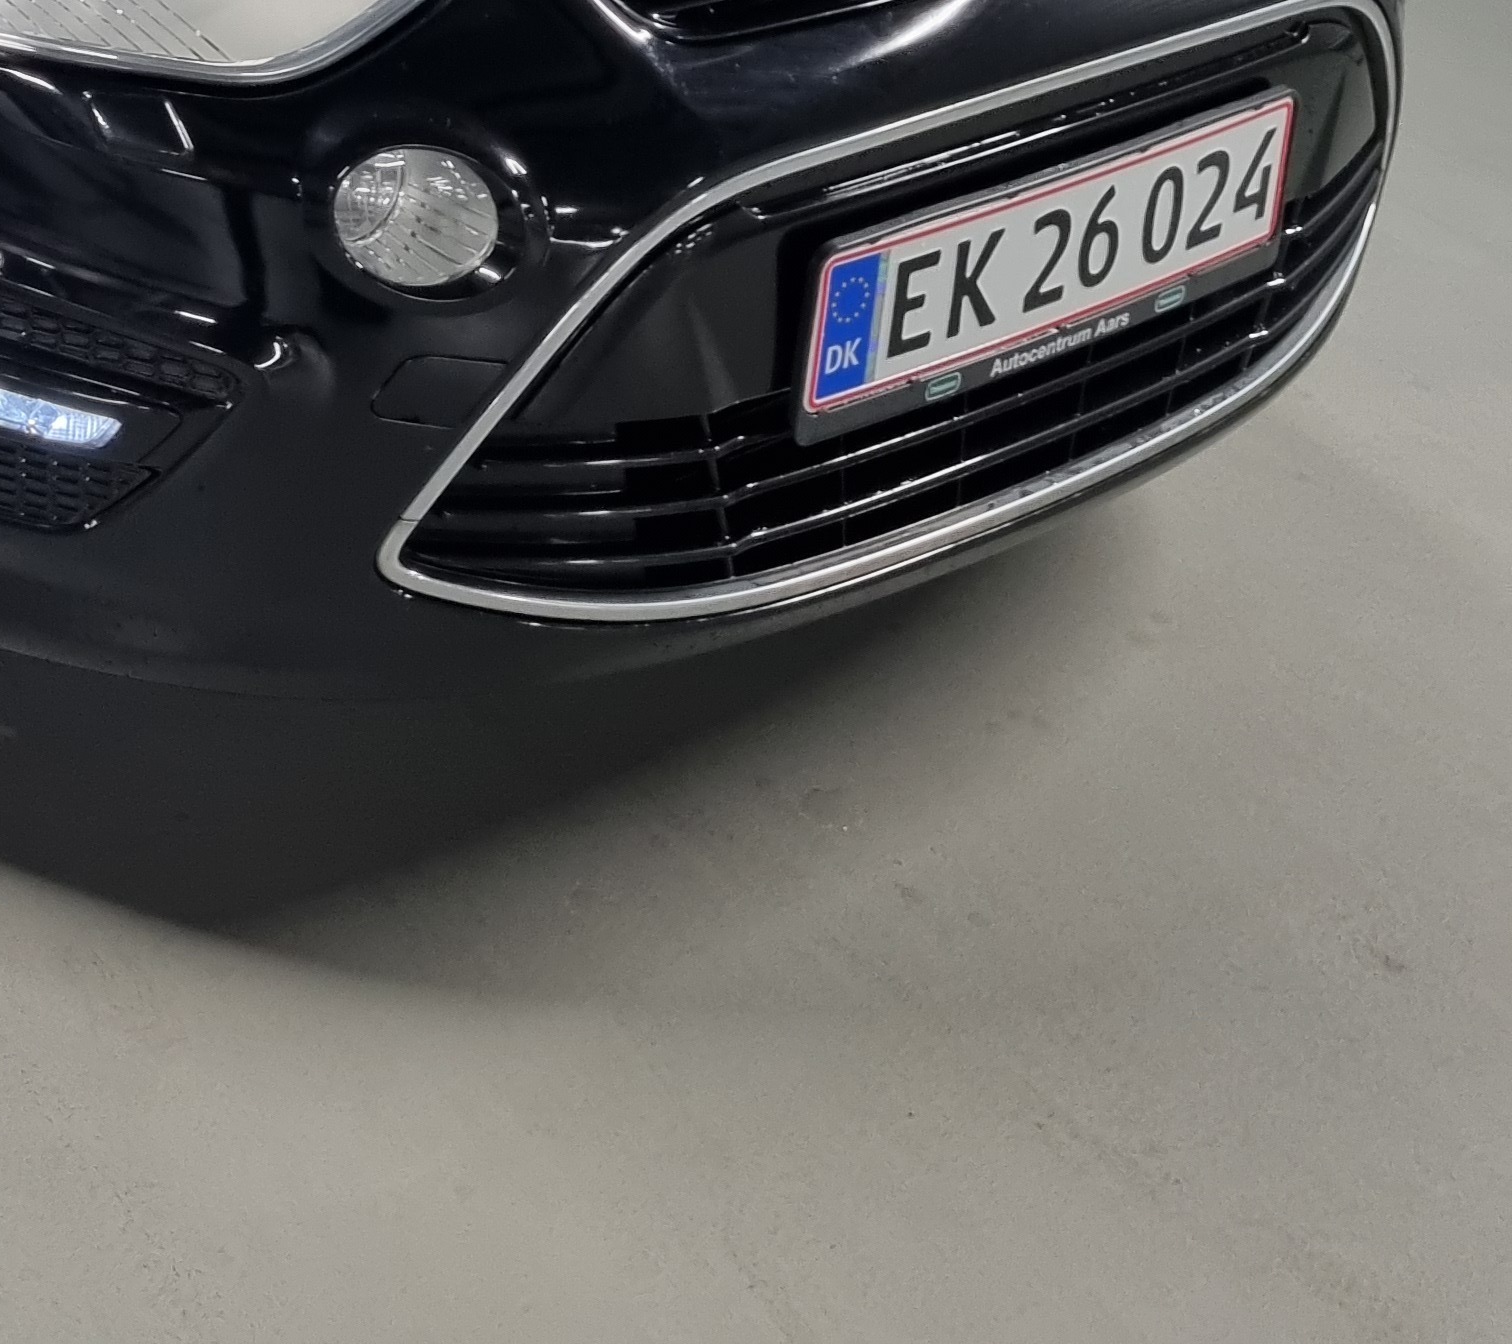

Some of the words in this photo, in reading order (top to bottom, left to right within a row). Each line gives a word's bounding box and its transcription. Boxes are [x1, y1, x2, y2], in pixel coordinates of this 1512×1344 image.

[886, 226, 1006, 358] EK
[1022, 184, 1120, 313] 26
[1141, 127, 1277, 264] 024
[824, 336, 861, 375] DK
[989, 328, 1093, 378] Autocentrum
[1094, 312, 1130, 336] Aars
